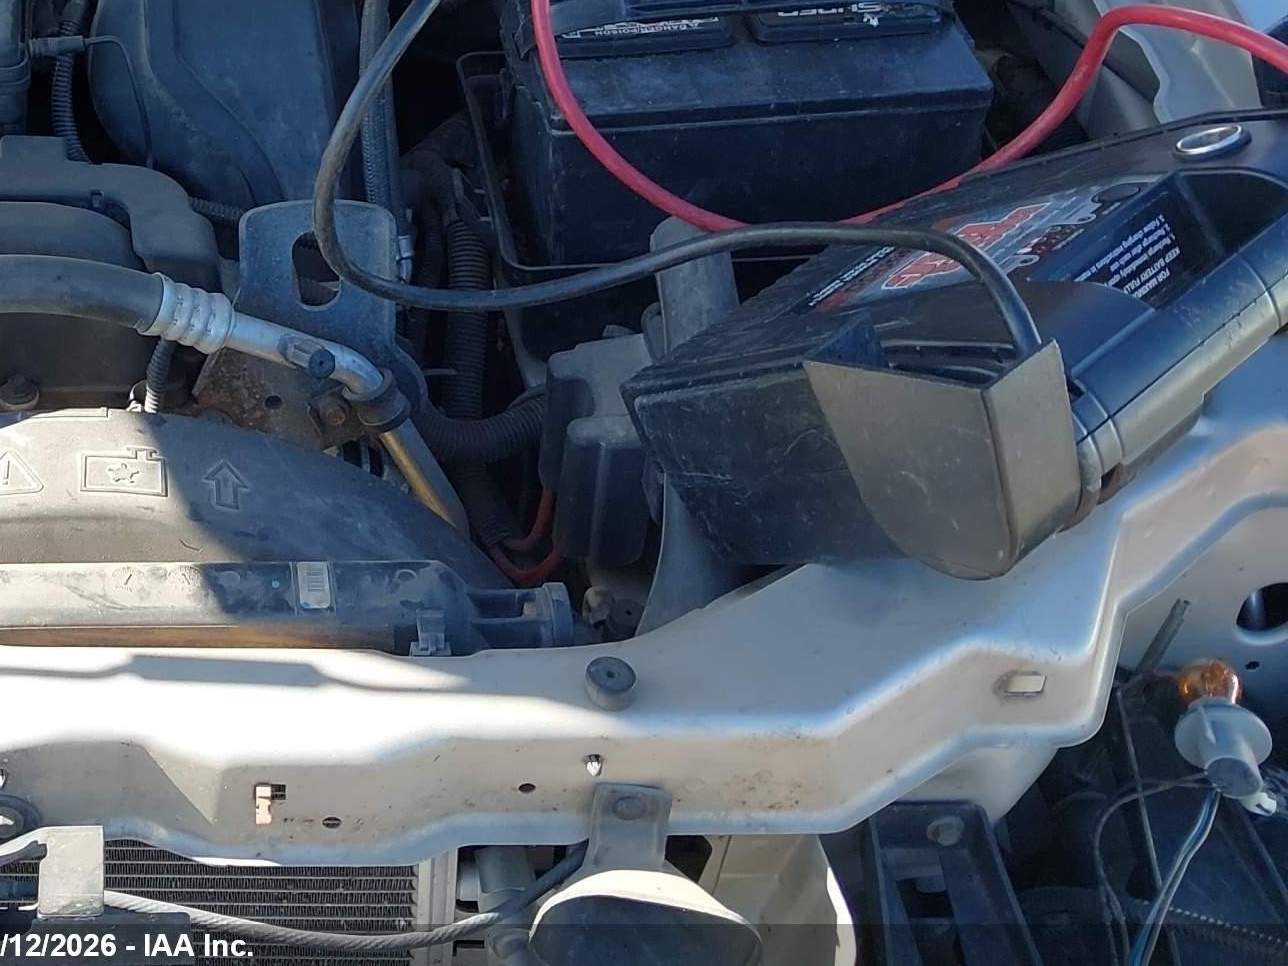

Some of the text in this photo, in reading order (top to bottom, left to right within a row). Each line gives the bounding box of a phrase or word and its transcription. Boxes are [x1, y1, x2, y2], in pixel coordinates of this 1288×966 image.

[1164, 246, 1181, 264] KEEP
[1140, 258, 1166, 282] BATTERY
[1133, 268, 1170, 299] FOR MAXIMU
